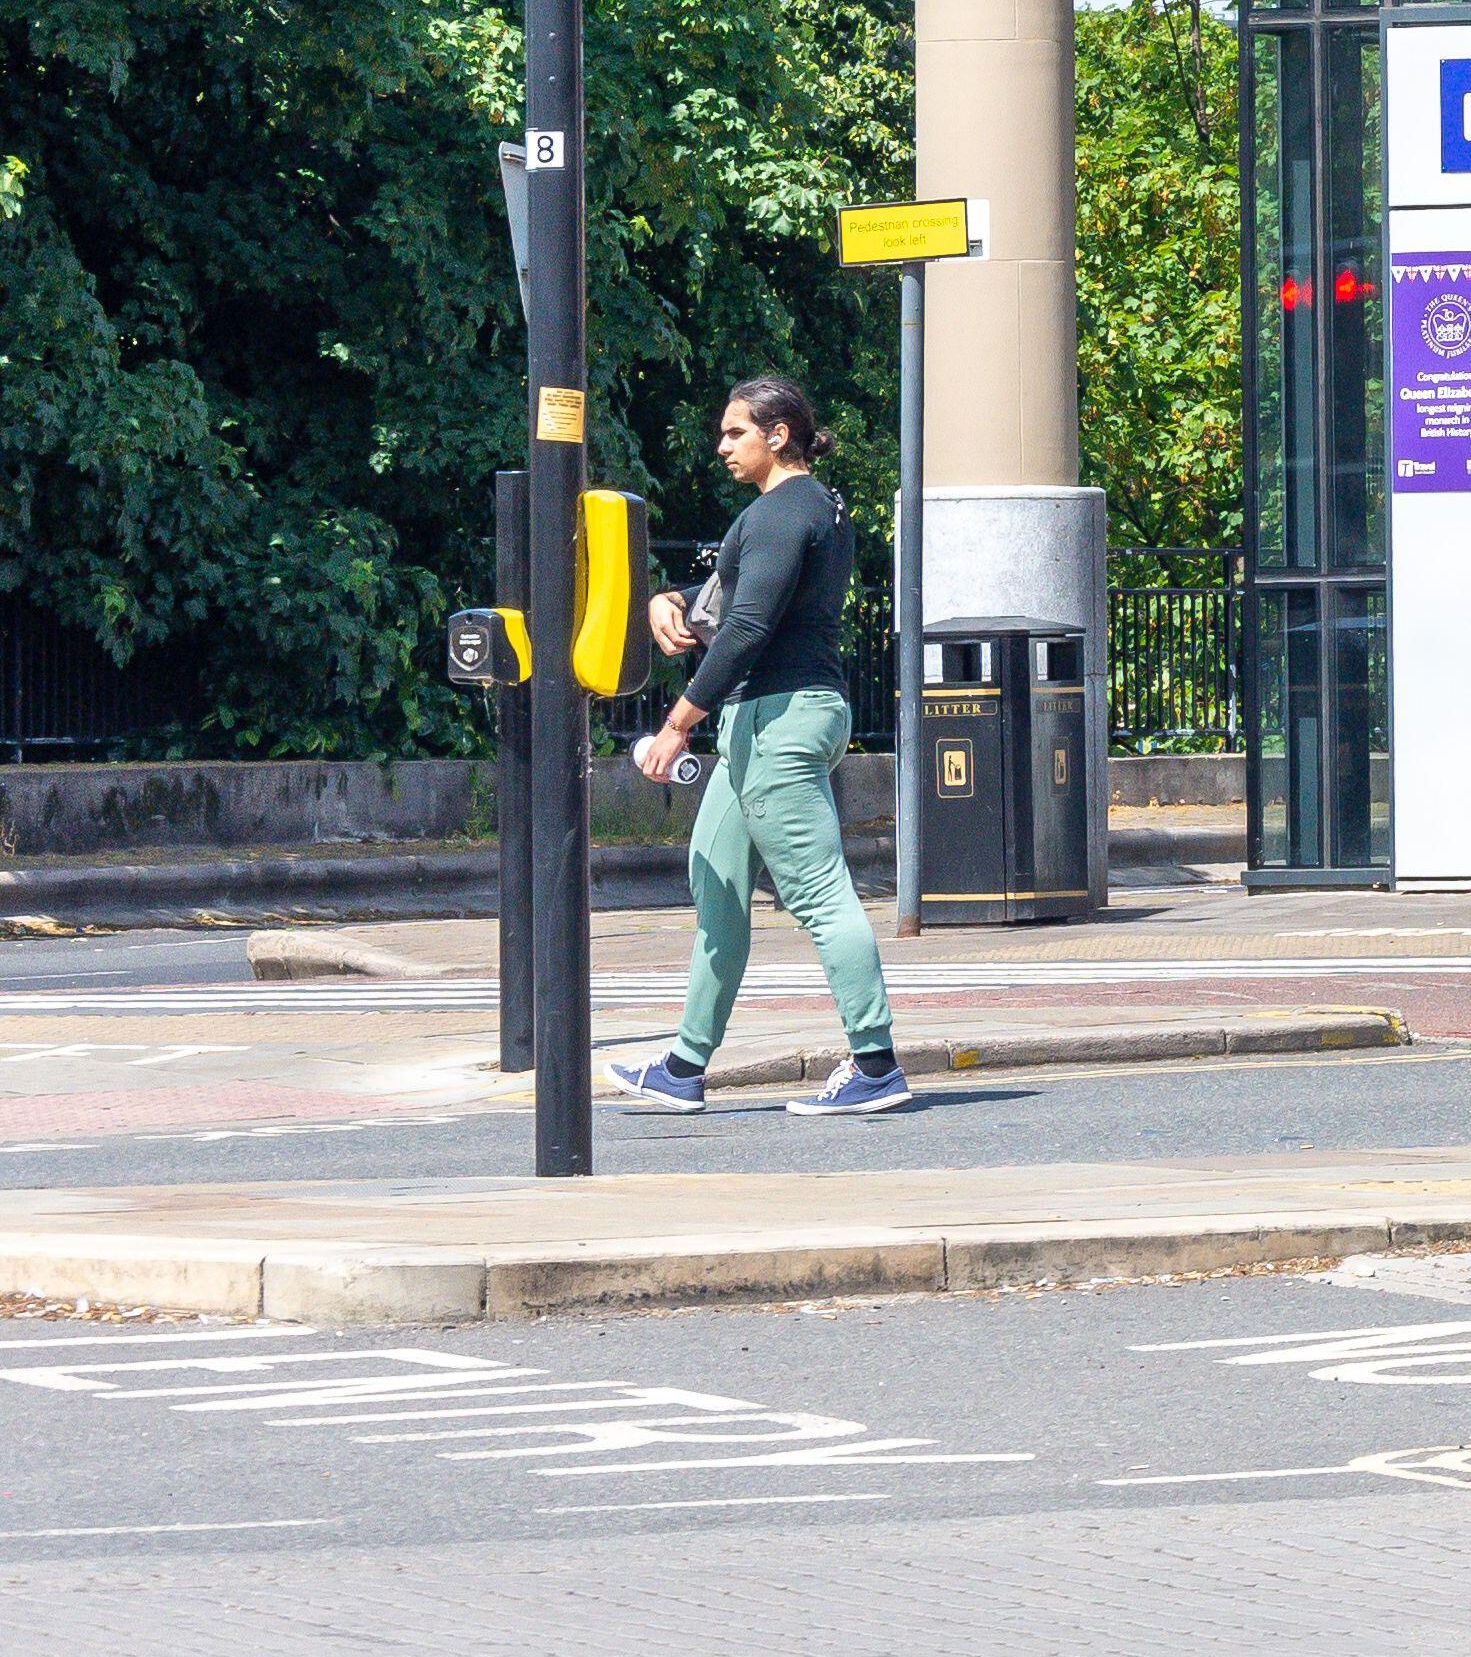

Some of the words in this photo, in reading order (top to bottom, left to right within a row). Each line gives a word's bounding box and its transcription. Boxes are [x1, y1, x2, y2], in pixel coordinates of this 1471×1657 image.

[537, 135, 554, 163] 8
[849, 220, 909, 234] Pedestrian
[912, 215, 960, 228] crossing
[883, 237, 905, 248] look
[909, 233, 926, 246] left
[1400, 387, 1436, 400] Queen
[1416, 403, 1446, 415] longest
[924, 703, 982, 716] LITTER
[2, 1346, 1037, 1477] ENTRY
